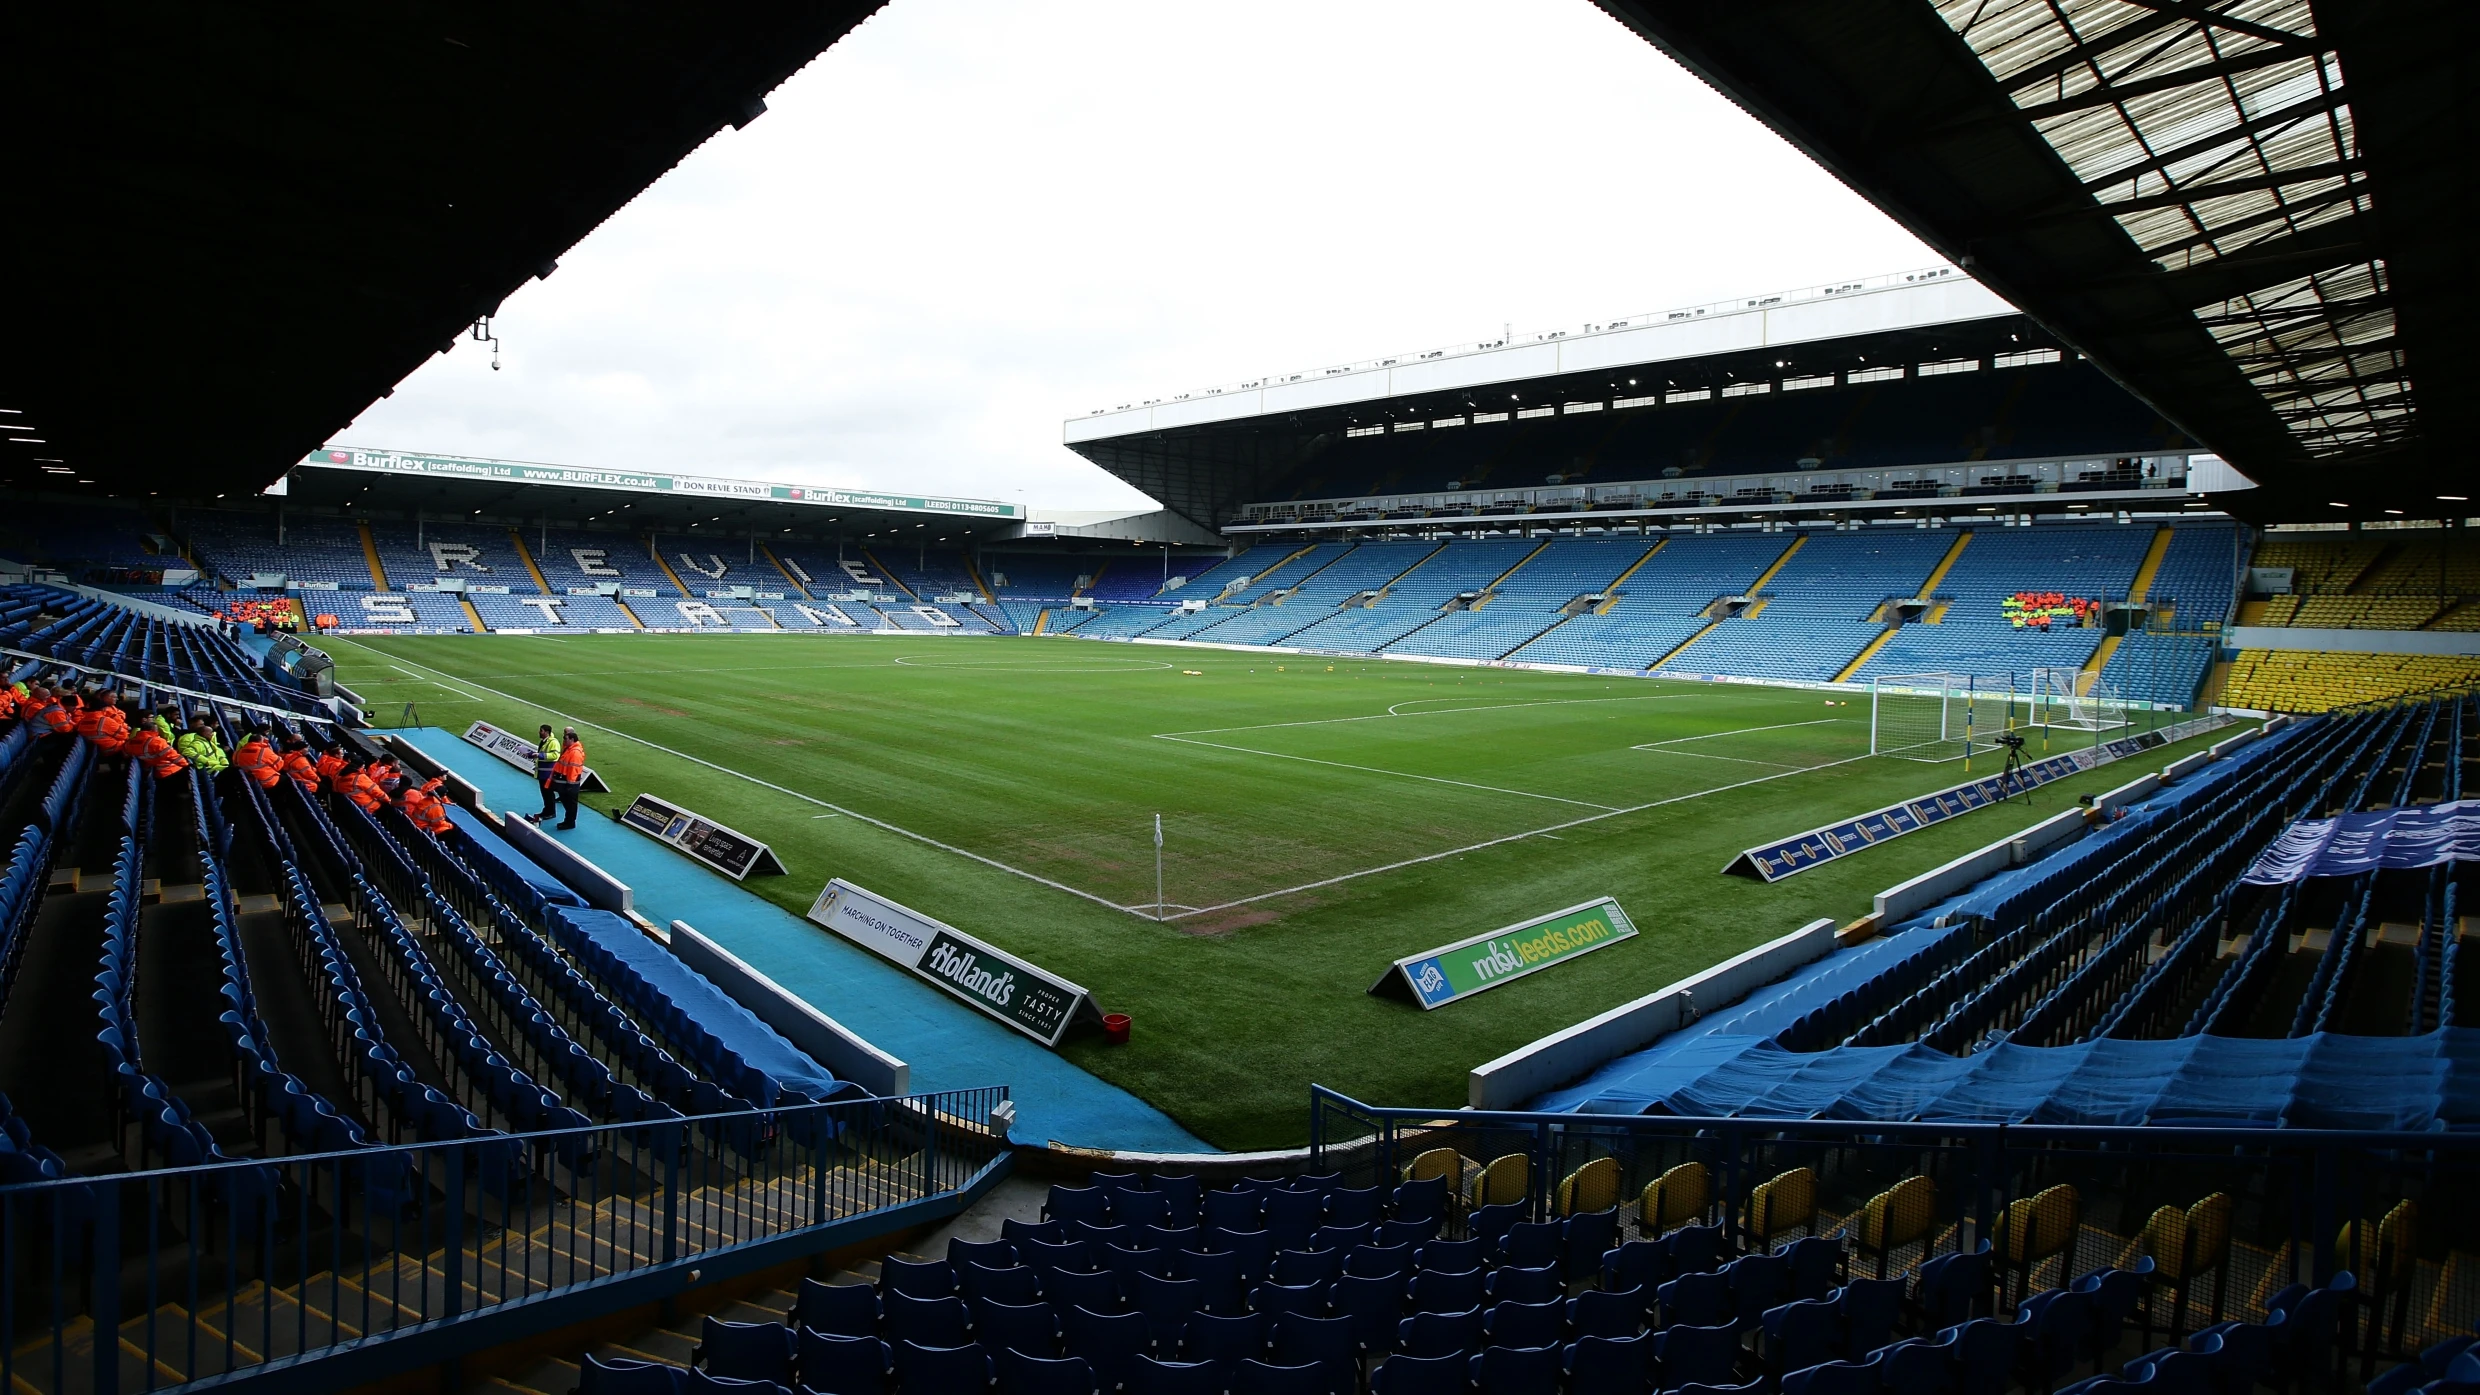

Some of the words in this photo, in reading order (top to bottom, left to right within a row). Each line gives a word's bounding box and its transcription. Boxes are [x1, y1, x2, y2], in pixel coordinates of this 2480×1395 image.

[353, 452, 424, 470] Burflex
[428, 463, 492, 476] (scaffolding)
[494, 467, 511, 476] Ltd
[523, 469, 656, 488] www.BURFLEX.co.uk
[684, 481, 705, 490] DON
[707, 483, 731, 492] REVIE
[733, 485, 761, 494] STAND
[804, 489, 850, 503] Burflex
[852, 496, 894, 506] (scaffolding)
[924, 500, 951, 510] (LEEDS)
[952, 503, 999, 513] 0113-8805605
[1726, 676, 1765, 685] Burflex
[1877, 687, 1941, 696] et365.com
[708, 834, 721, 847] Living
[720, 839, 734, 851] space
[841, 905, 876, 926] MARCHING
[874, 921, 887, 932] ON
[886, 926, 923, 949] TOGETHER
[929, 942, 1016, 1006] Holland's
[1423, 970, 1437, 990] FLAG
[1037, 989, 1060, 1003] PROPER
[1018, 1009, 1035, 1022] SINCE
[1023, 995, 1062, 1021] TASTY
